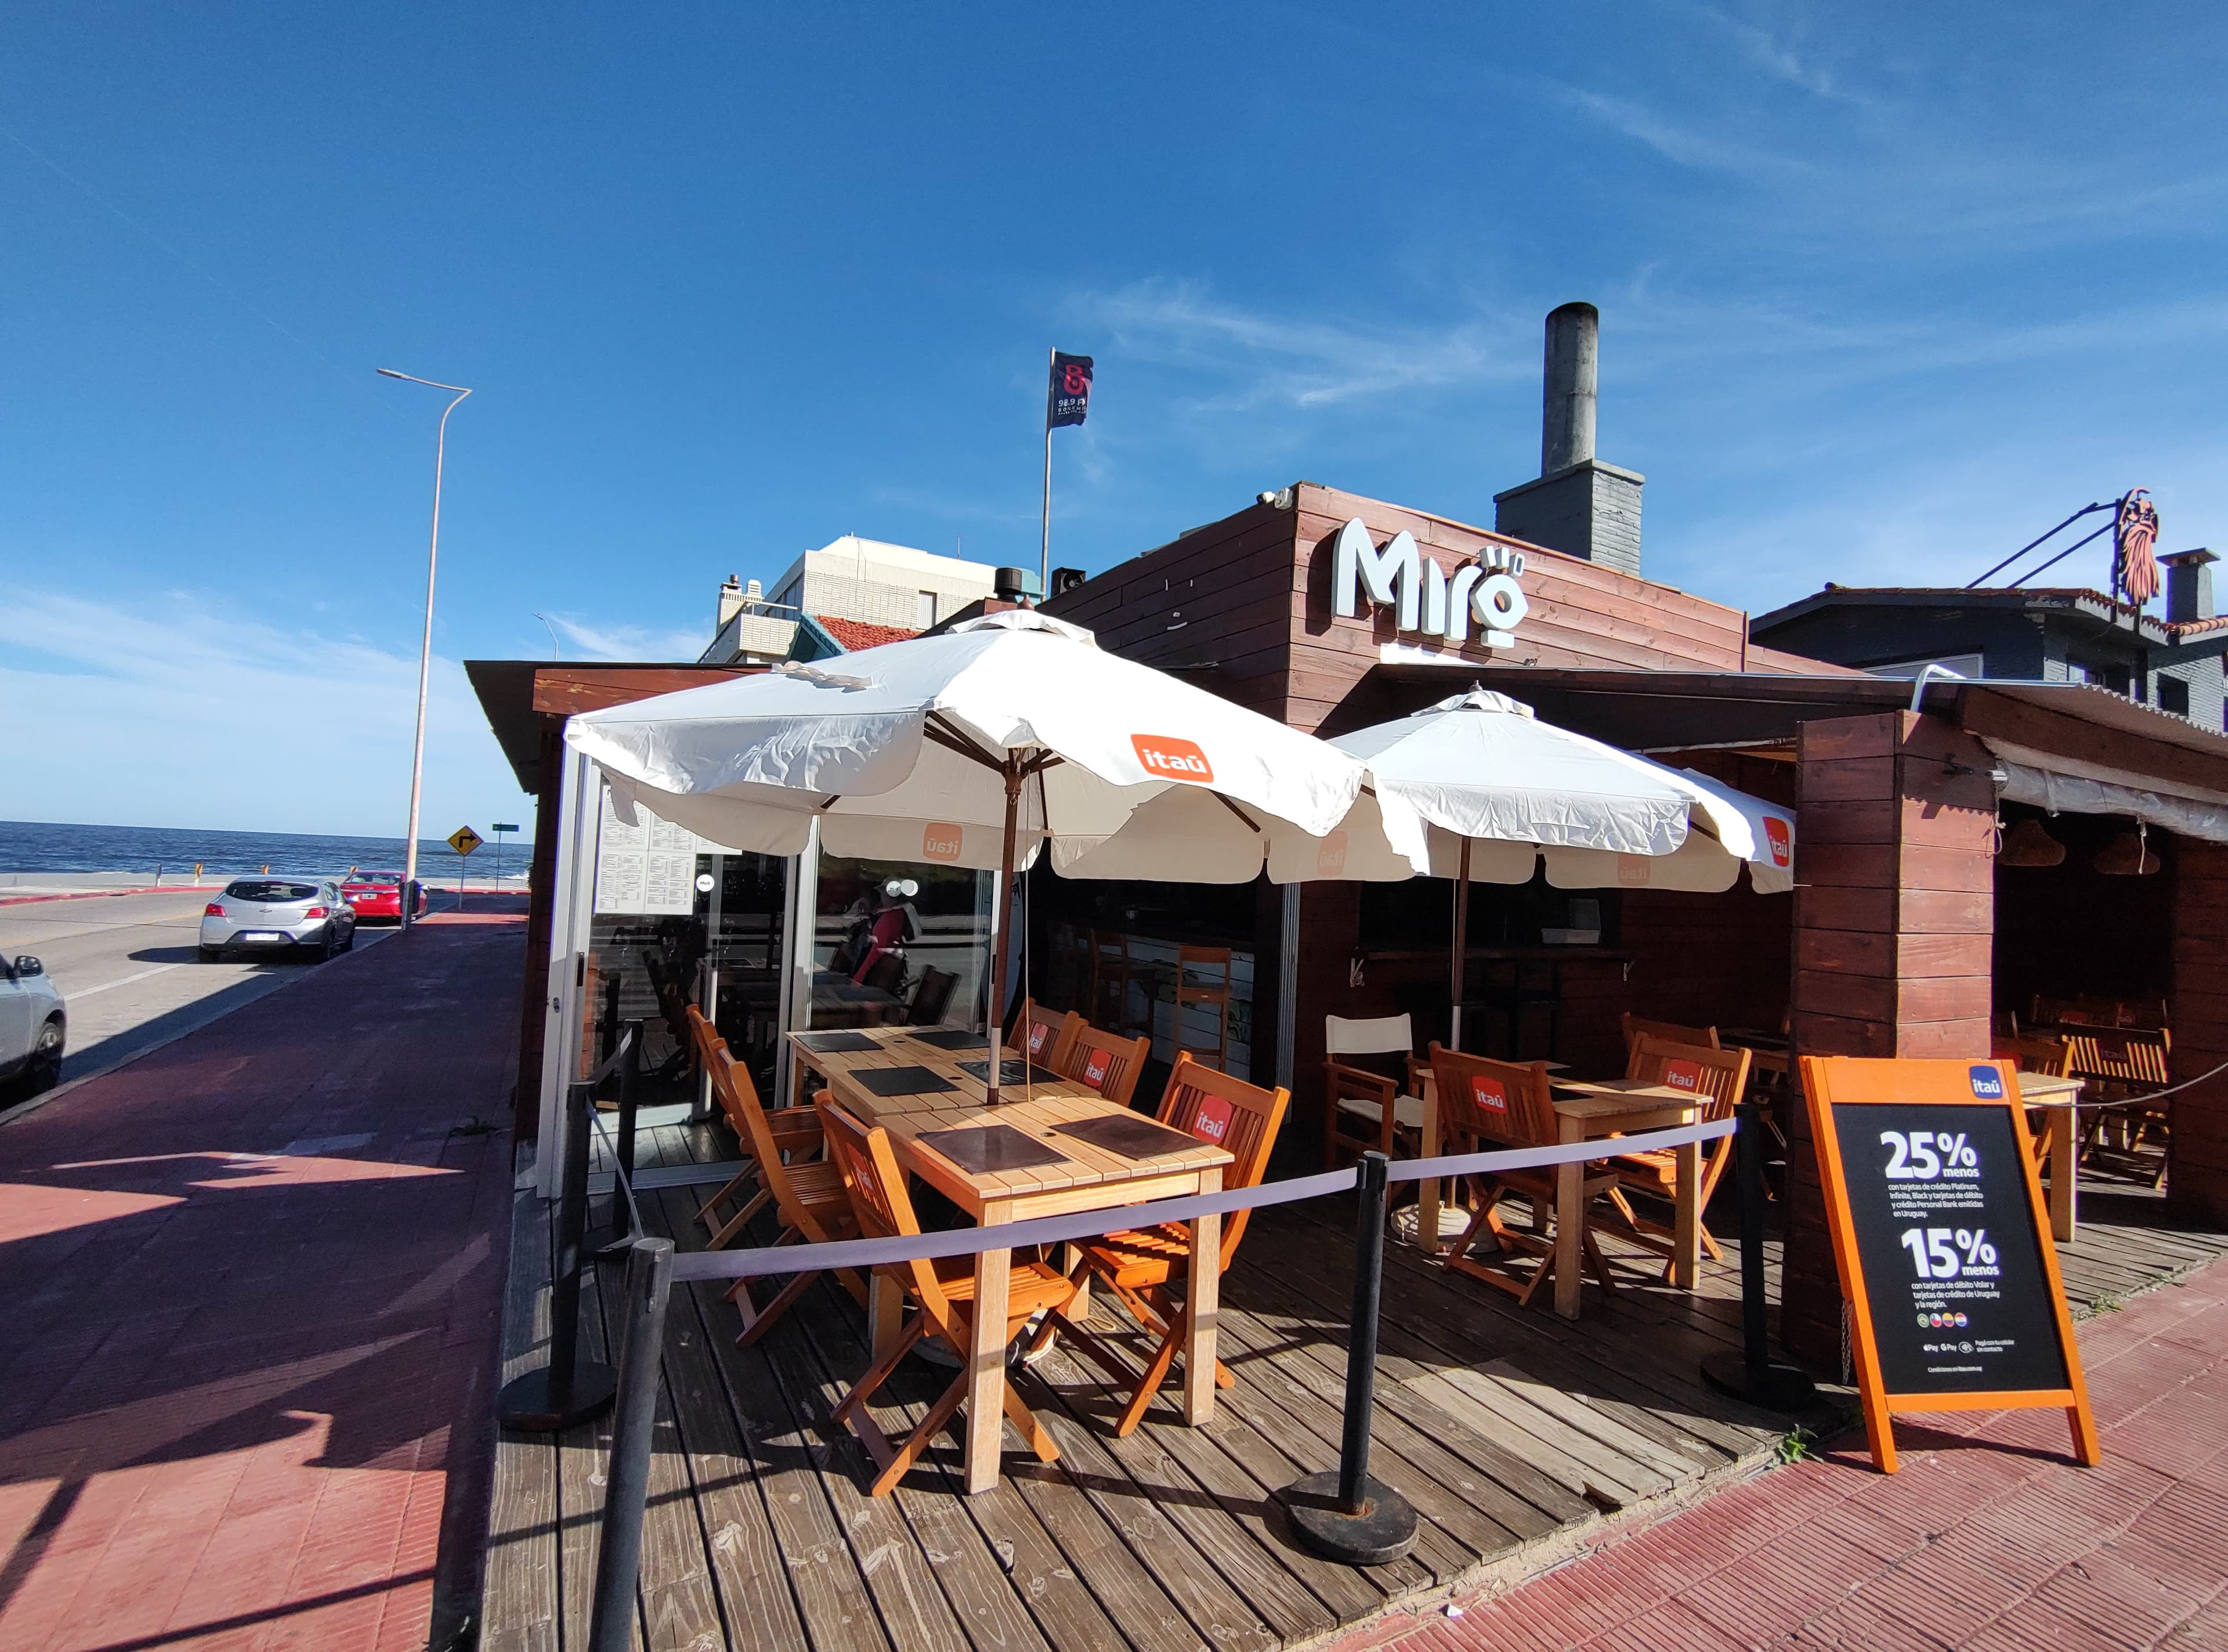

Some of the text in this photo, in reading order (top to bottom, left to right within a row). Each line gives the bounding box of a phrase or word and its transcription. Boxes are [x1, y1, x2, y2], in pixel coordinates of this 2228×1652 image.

[1058, 398, 1075, 407] 98.9
[1880, 1131, 1977, 1179] 25%
[1943, 1168, 1980, 1177] menos
[1900, 1183, 1922, 1191] tarjetas
[1951, 1183, 1979, 1191] Platinum,
[1901, 1228, 1996, 1278] 15%
[1962, 1266, 1999, 1275] menos
[1923, 1281, 1945, 1290] tarjetas
[1954, 1281, 1973, 1289] débito
[1913, 1291, 1936, 1300] tarjetas
[1974, 1290, 2000, 1299] Uruguay
[1926, 1300, 1947, 1309] región.
[1947, 1344, 1957, 1352] Pay
